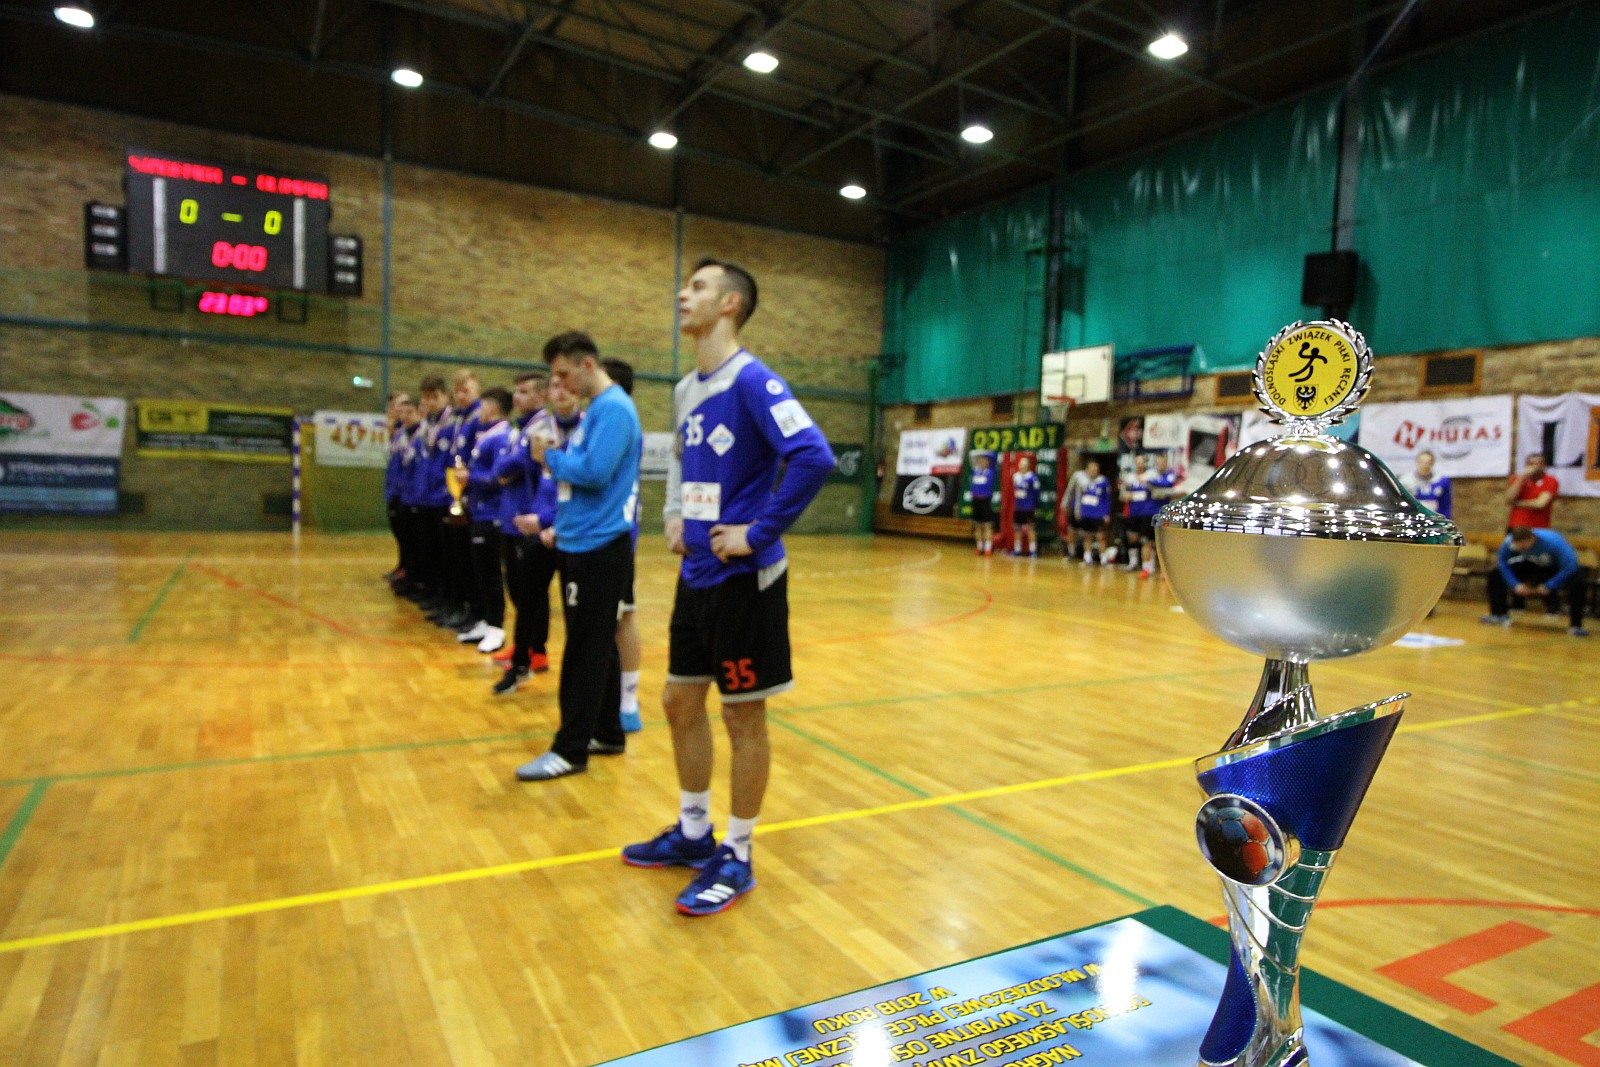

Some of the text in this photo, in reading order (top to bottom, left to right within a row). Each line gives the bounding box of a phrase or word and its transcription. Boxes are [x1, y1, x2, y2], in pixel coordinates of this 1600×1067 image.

[180, 199, 198, 224] 0
[264, 210, 282, 235] 0
[1265, 330, 1352, 406] DOLNOŚLĄSKI ZWIĄZEK PIŁKI RĘCZNEJ
[721, 657, 757, 691] 35
[812, 986, 957, 1034] W 2018 ROKU
[941, 968, 1087, 1019] MŁODZIEŻOWEJ
[1019, 1000, 1057, 1018] ZA
[882, 1009, 947, 1037] PIŁCE
[923, 1011, 1028, 1050] WYBITNE
